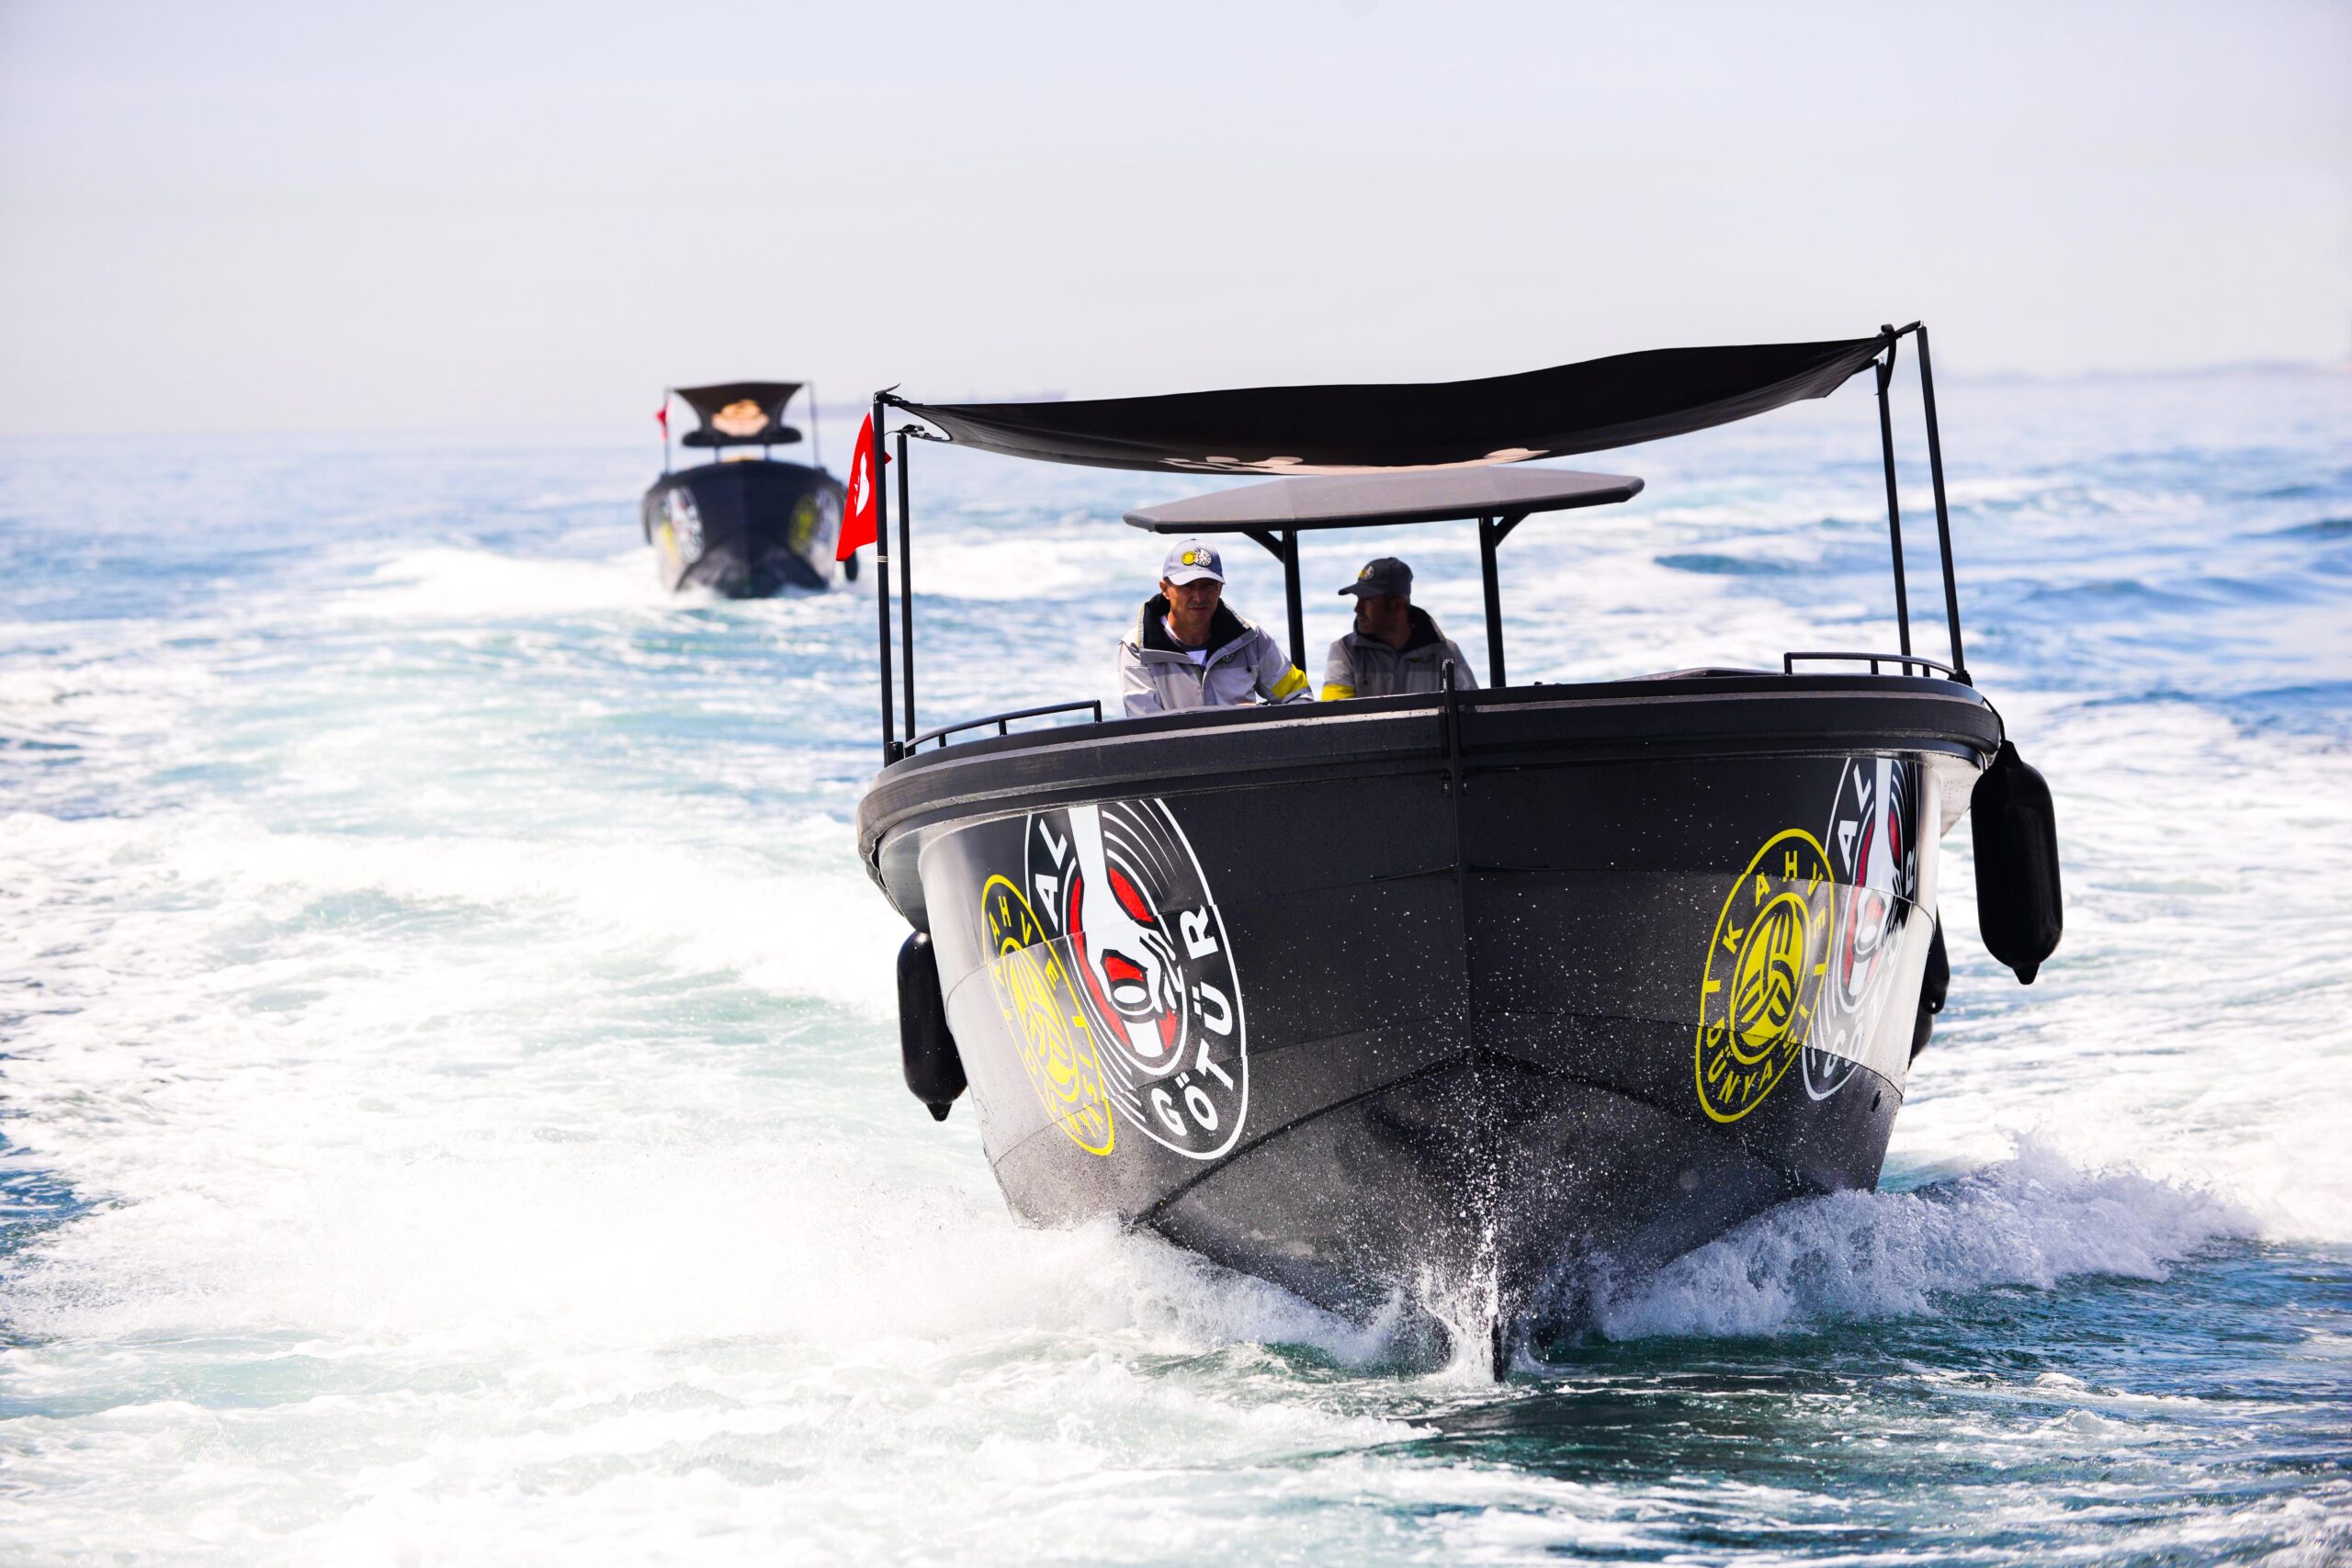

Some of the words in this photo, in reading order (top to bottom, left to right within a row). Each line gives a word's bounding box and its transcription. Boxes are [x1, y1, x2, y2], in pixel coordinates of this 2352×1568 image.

[1035, 818, 1068, 931] AL
[1838, 763, 1874, 876] AL
[1722, 851, 1826, 953] KAHVE
[1150, 905, 1234, 1136] GÖTÜR
[1706, 1004, 1811, 1104] DÜNYASI
